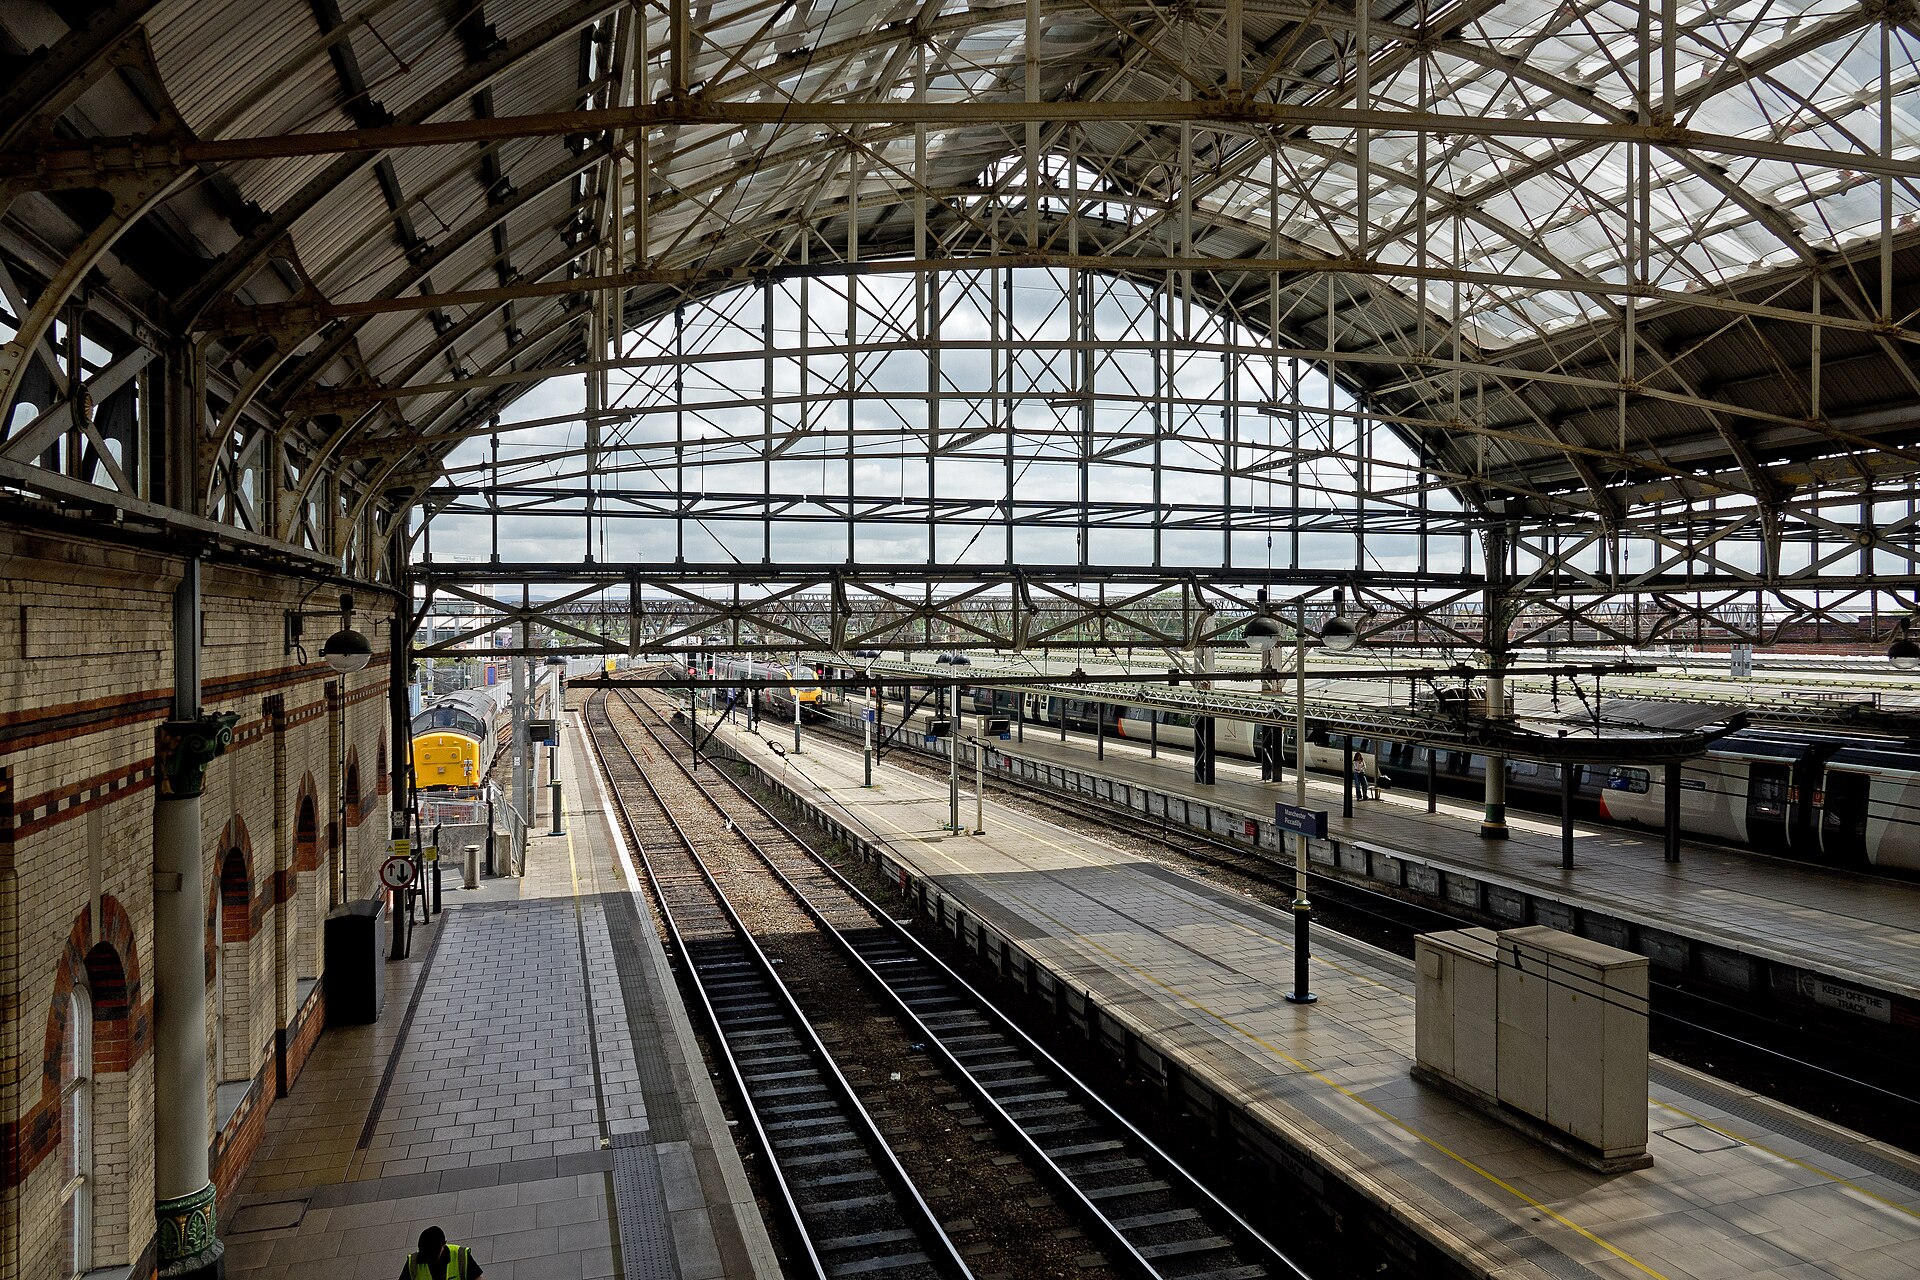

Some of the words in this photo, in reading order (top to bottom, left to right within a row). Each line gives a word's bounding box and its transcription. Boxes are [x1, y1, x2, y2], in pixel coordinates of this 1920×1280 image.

[1284, 809, 1306, 819] Manchester
[1284, 816, 1302, 828] Piccadilly
[1822, 985, 1844, 997] KEEP
[1846, 991, 1863, 1002] OFF
[1865, 996, 1882, 1008] THE
[1837, 999, 1867, 1014] TRACK
